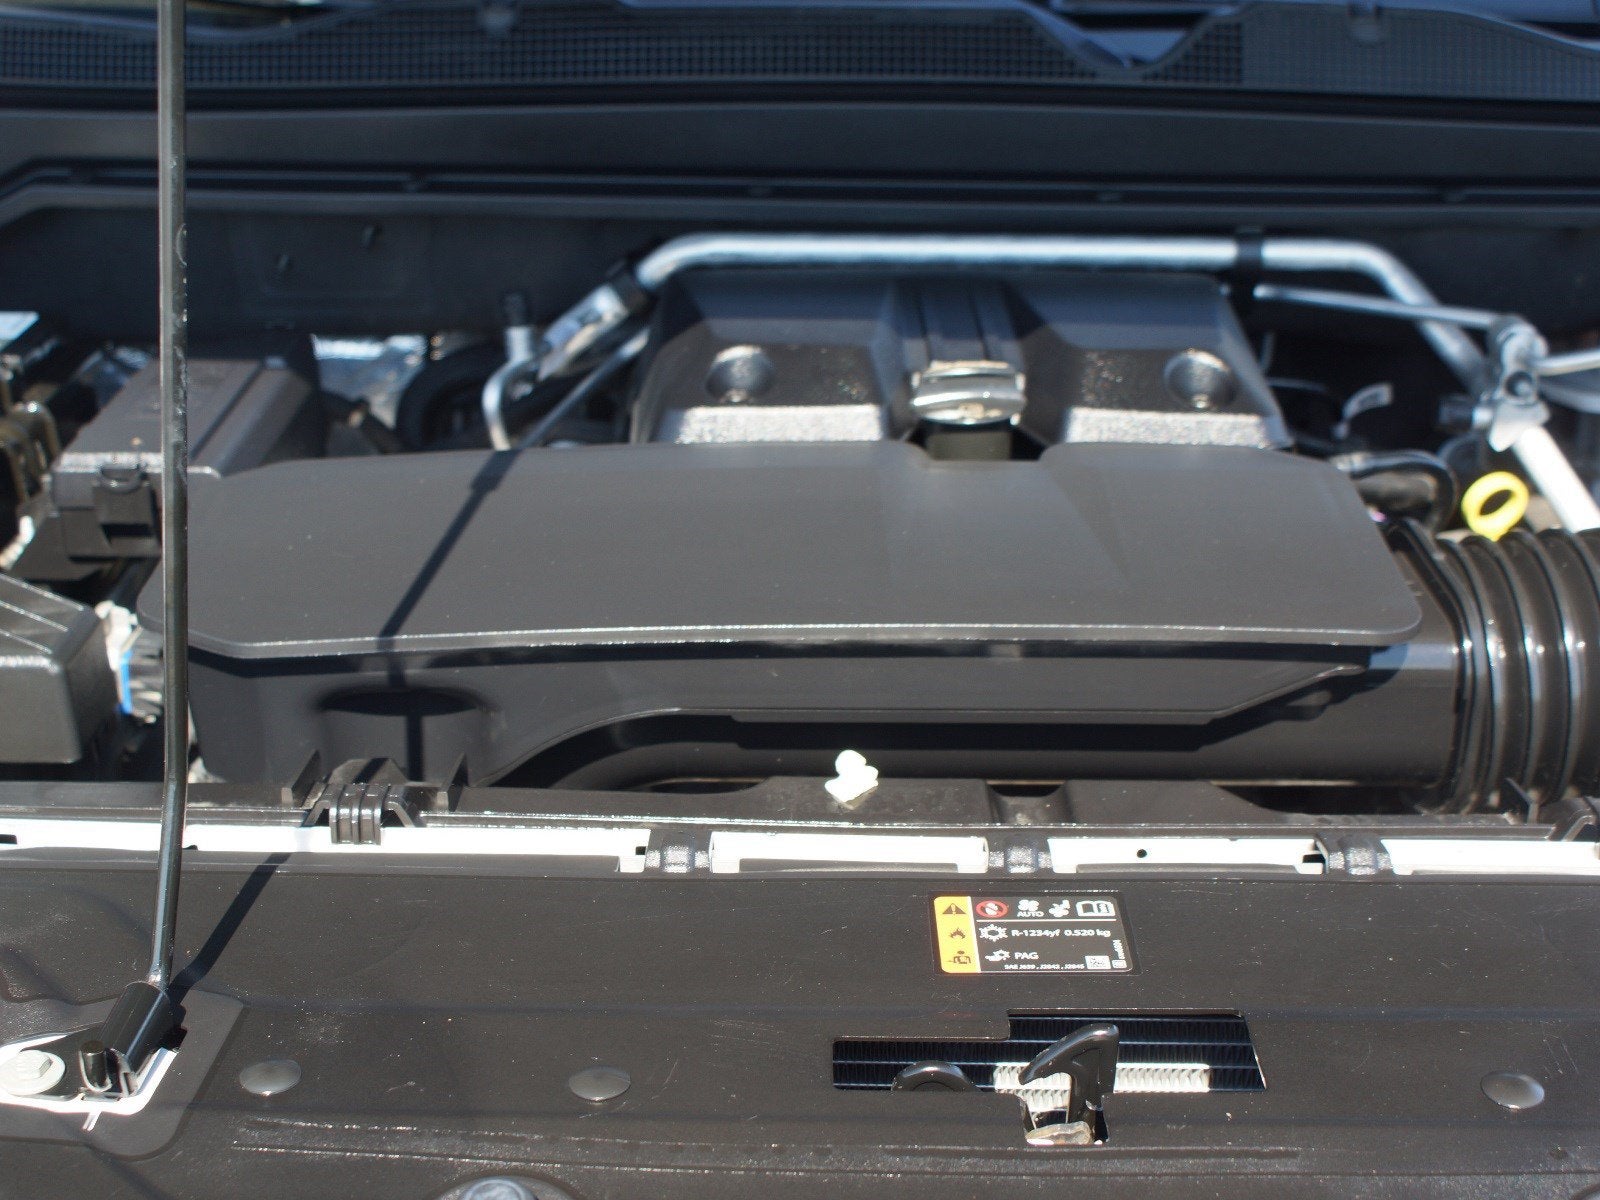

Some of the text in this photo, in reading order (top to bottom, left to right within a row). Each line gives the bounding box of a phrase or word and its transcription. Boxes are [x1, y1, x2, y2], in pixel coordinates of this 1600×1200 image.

[1016, 910, 1045, 918] AUTO
[1011, 928, 1111, 938] R-1234yf 0.520 kg
[1014, 952, 1040, 960] PAG
